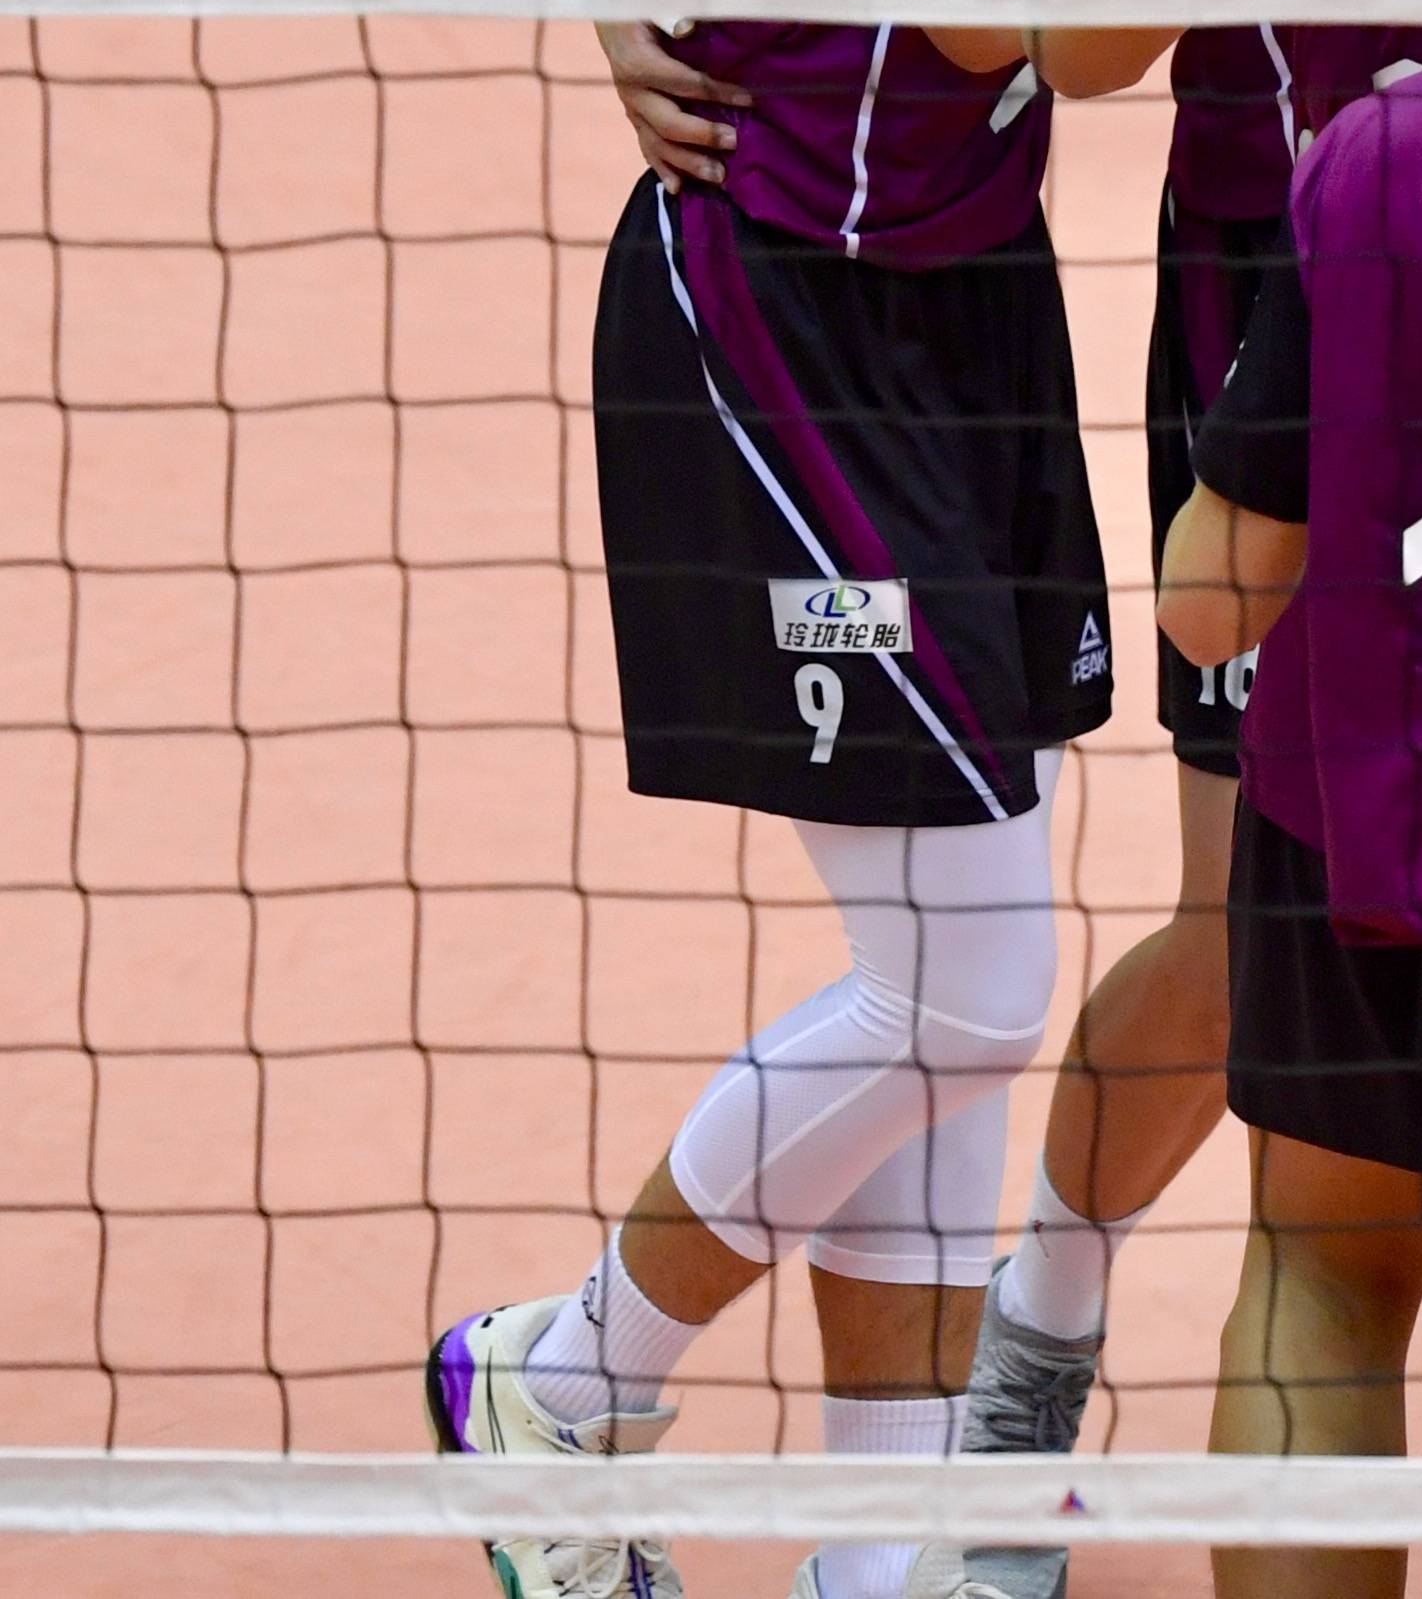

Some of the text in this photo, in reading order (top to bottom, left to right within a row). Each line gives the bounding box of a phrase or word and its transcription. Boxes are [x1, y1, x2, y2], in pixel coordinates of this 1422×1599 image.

[784, 622, 901, 648] 玲珑轮胎
[1071, 645, 1110, 685] PEAK
[794, 663, 844, 763] 9
